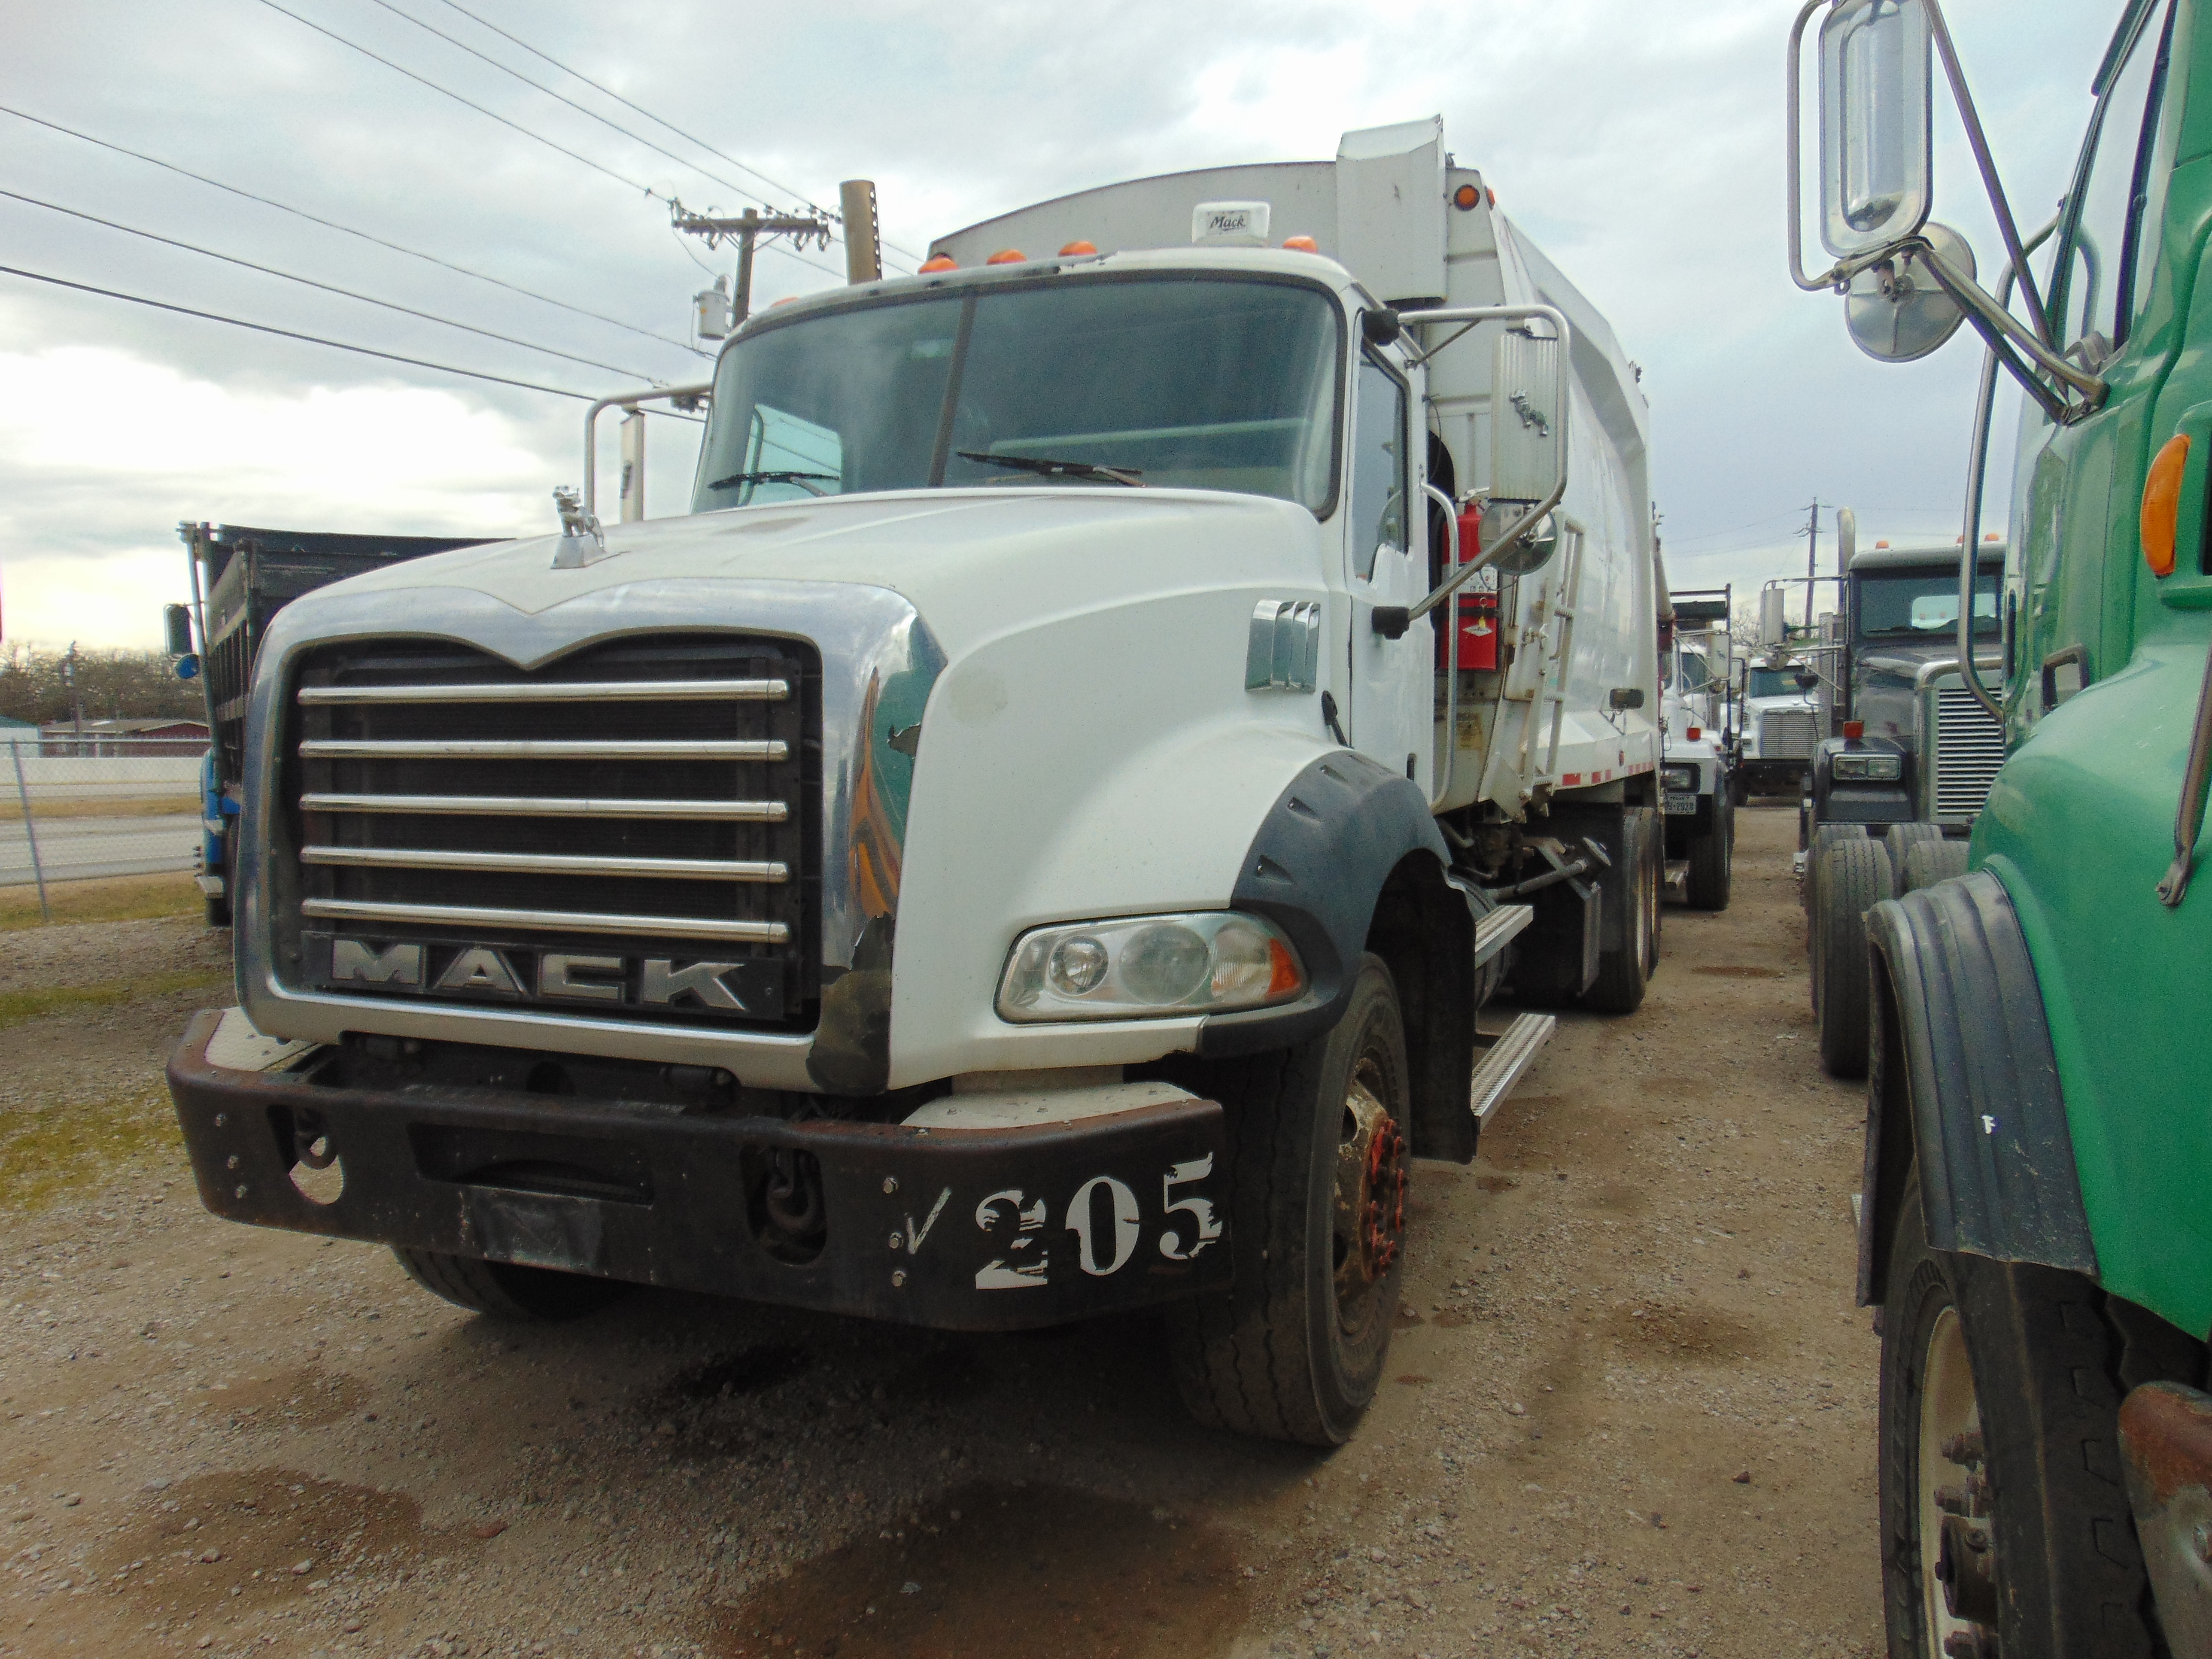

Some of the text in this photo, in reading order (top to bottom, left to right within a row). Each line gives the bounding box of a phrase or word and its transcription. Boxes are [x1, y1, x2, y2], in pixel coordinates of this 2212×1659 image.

[1209, 216, 1246, 229] Mack
[332, 939, 746, 1011] MACK
[975, 1152, 1222, 1289] 205
